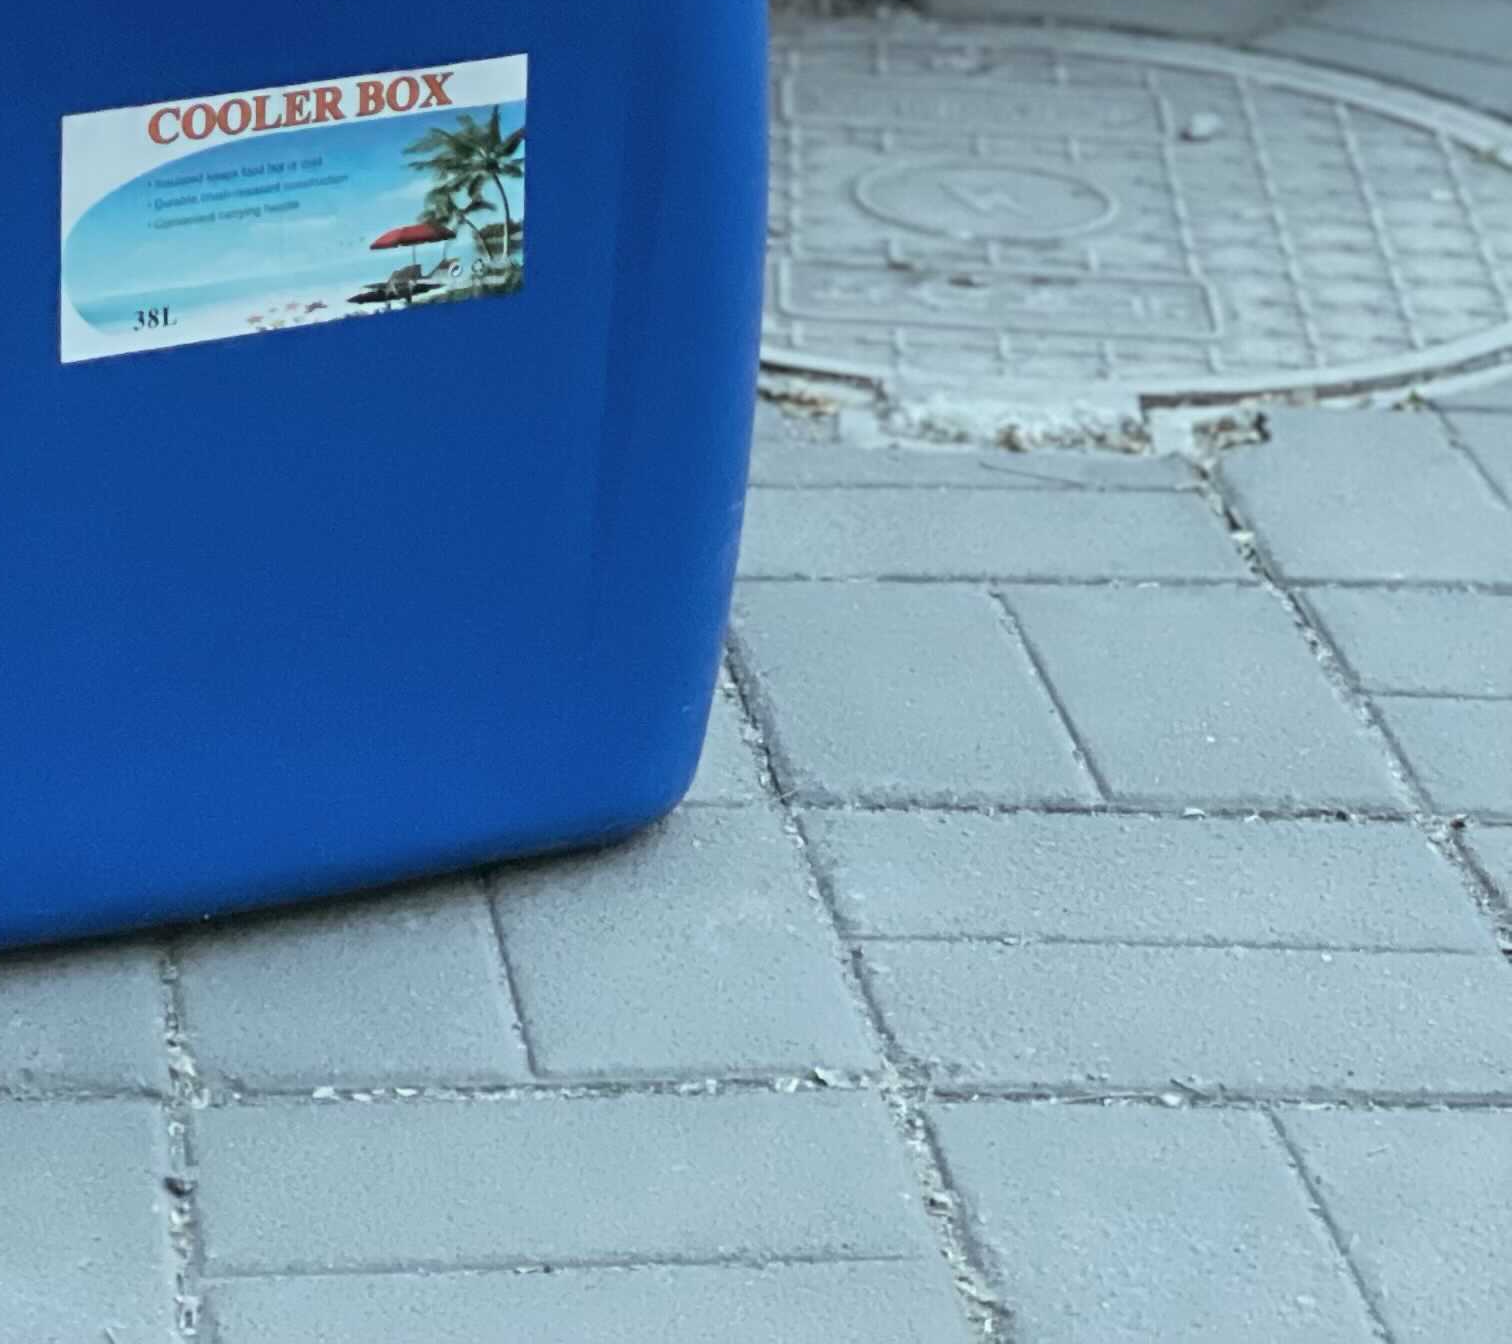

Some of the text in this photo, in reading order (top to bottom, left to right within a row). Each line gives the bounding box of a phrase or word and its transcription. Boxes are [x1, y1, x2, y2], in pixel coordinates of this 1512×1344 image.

[147, 71, 455, 146] COOLER BOX
[133, 306, 178, 332] 38L
